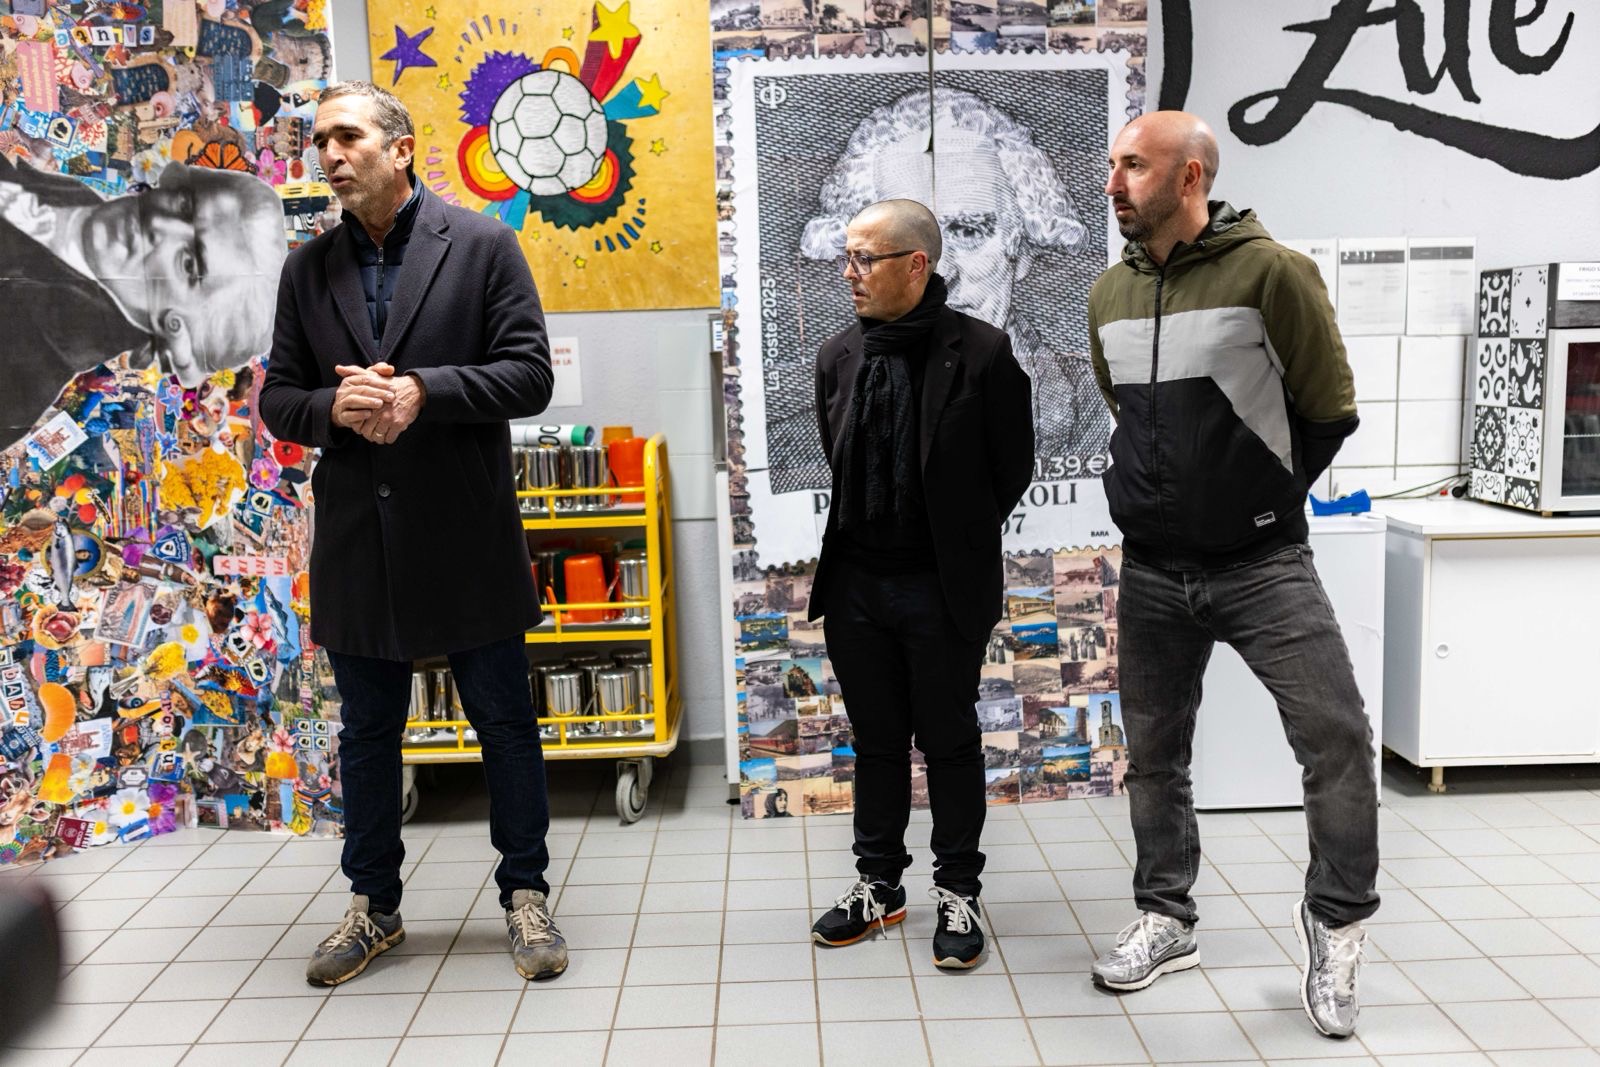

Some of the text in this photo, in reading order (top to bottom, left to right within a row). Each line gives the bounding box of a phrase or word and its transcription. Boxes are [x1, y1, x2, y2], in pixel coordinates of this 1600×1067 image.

[761, 277, 777, 318] 2025
[766, 370, 781, 392] La
[1035, 454, 1106, 480] 1,39 €
